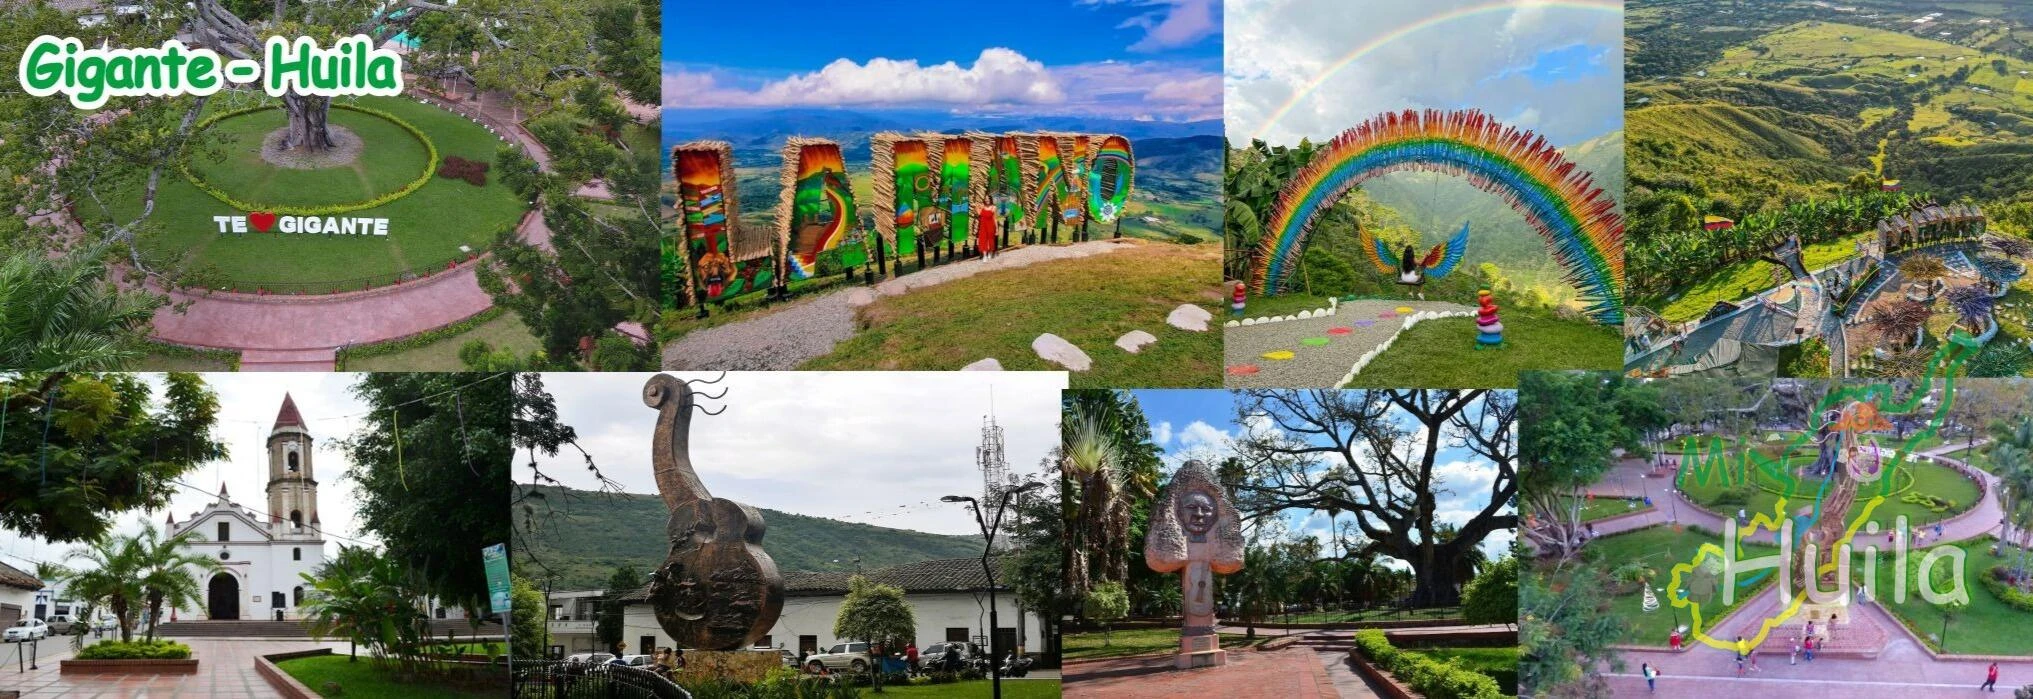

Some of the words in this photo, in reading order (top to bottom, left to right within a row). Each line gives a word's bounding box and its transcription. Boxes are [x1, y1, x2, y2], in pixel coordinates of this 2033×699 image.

[213, 215, 248, 233] TE
[278, 215, 390, 236] GIGANTE
[672, 137, 872, 303] LA
[871, 128, 1135, 258] MANO
